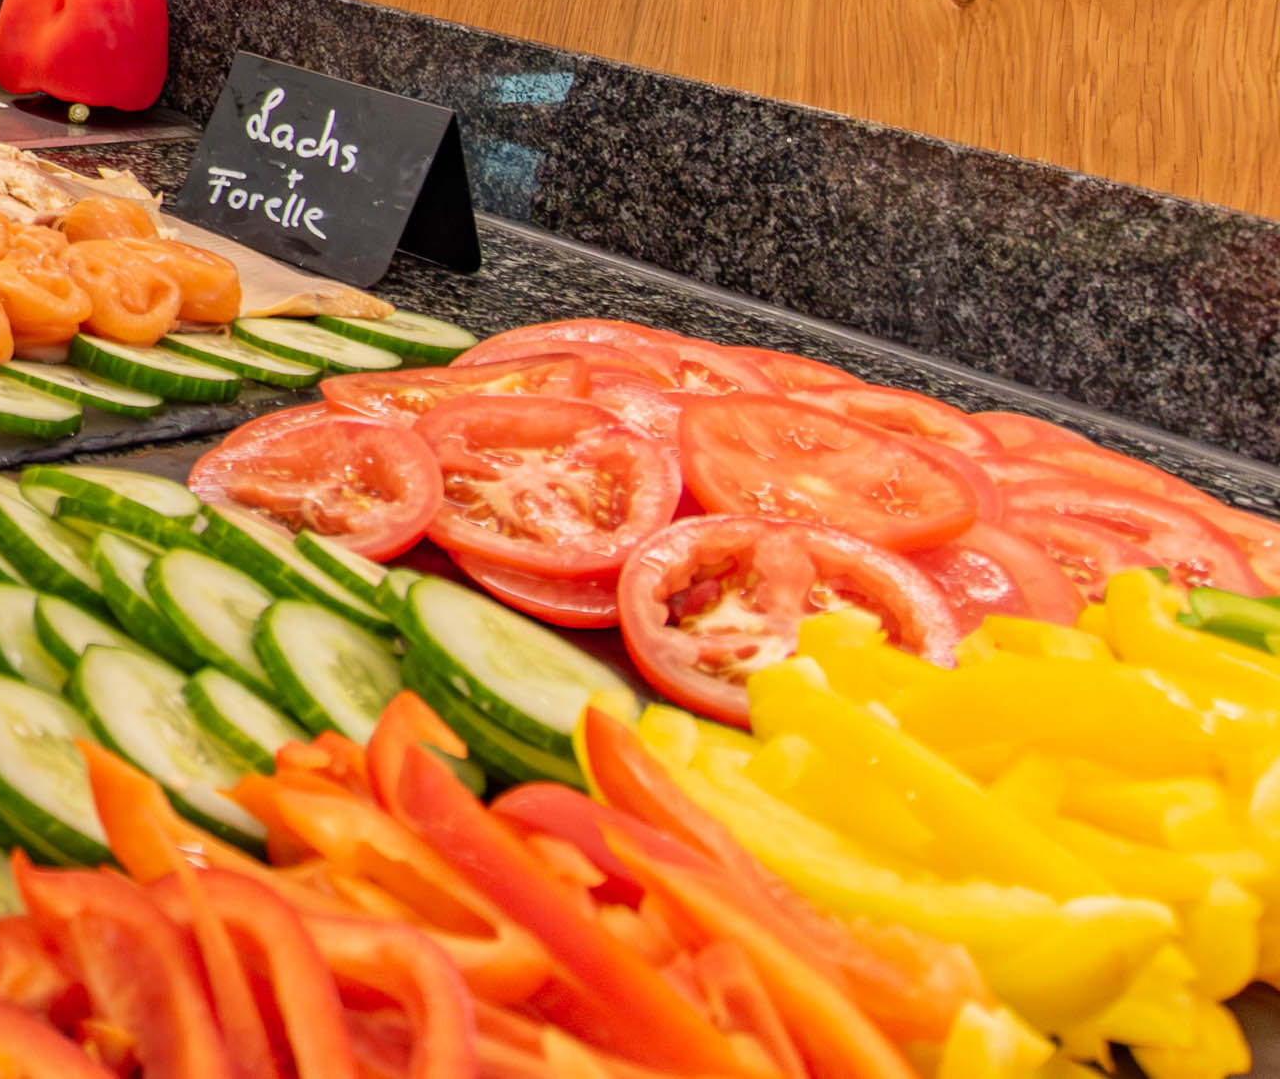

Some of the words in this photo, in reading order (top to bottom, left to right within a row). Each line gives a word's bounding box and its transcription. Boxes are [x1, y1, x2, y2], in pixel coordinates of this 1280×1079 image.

[245, 87, 359, 173] Lachs
[208, 166, 328, 240] Forelle
[286, 168, 304, 190] +
